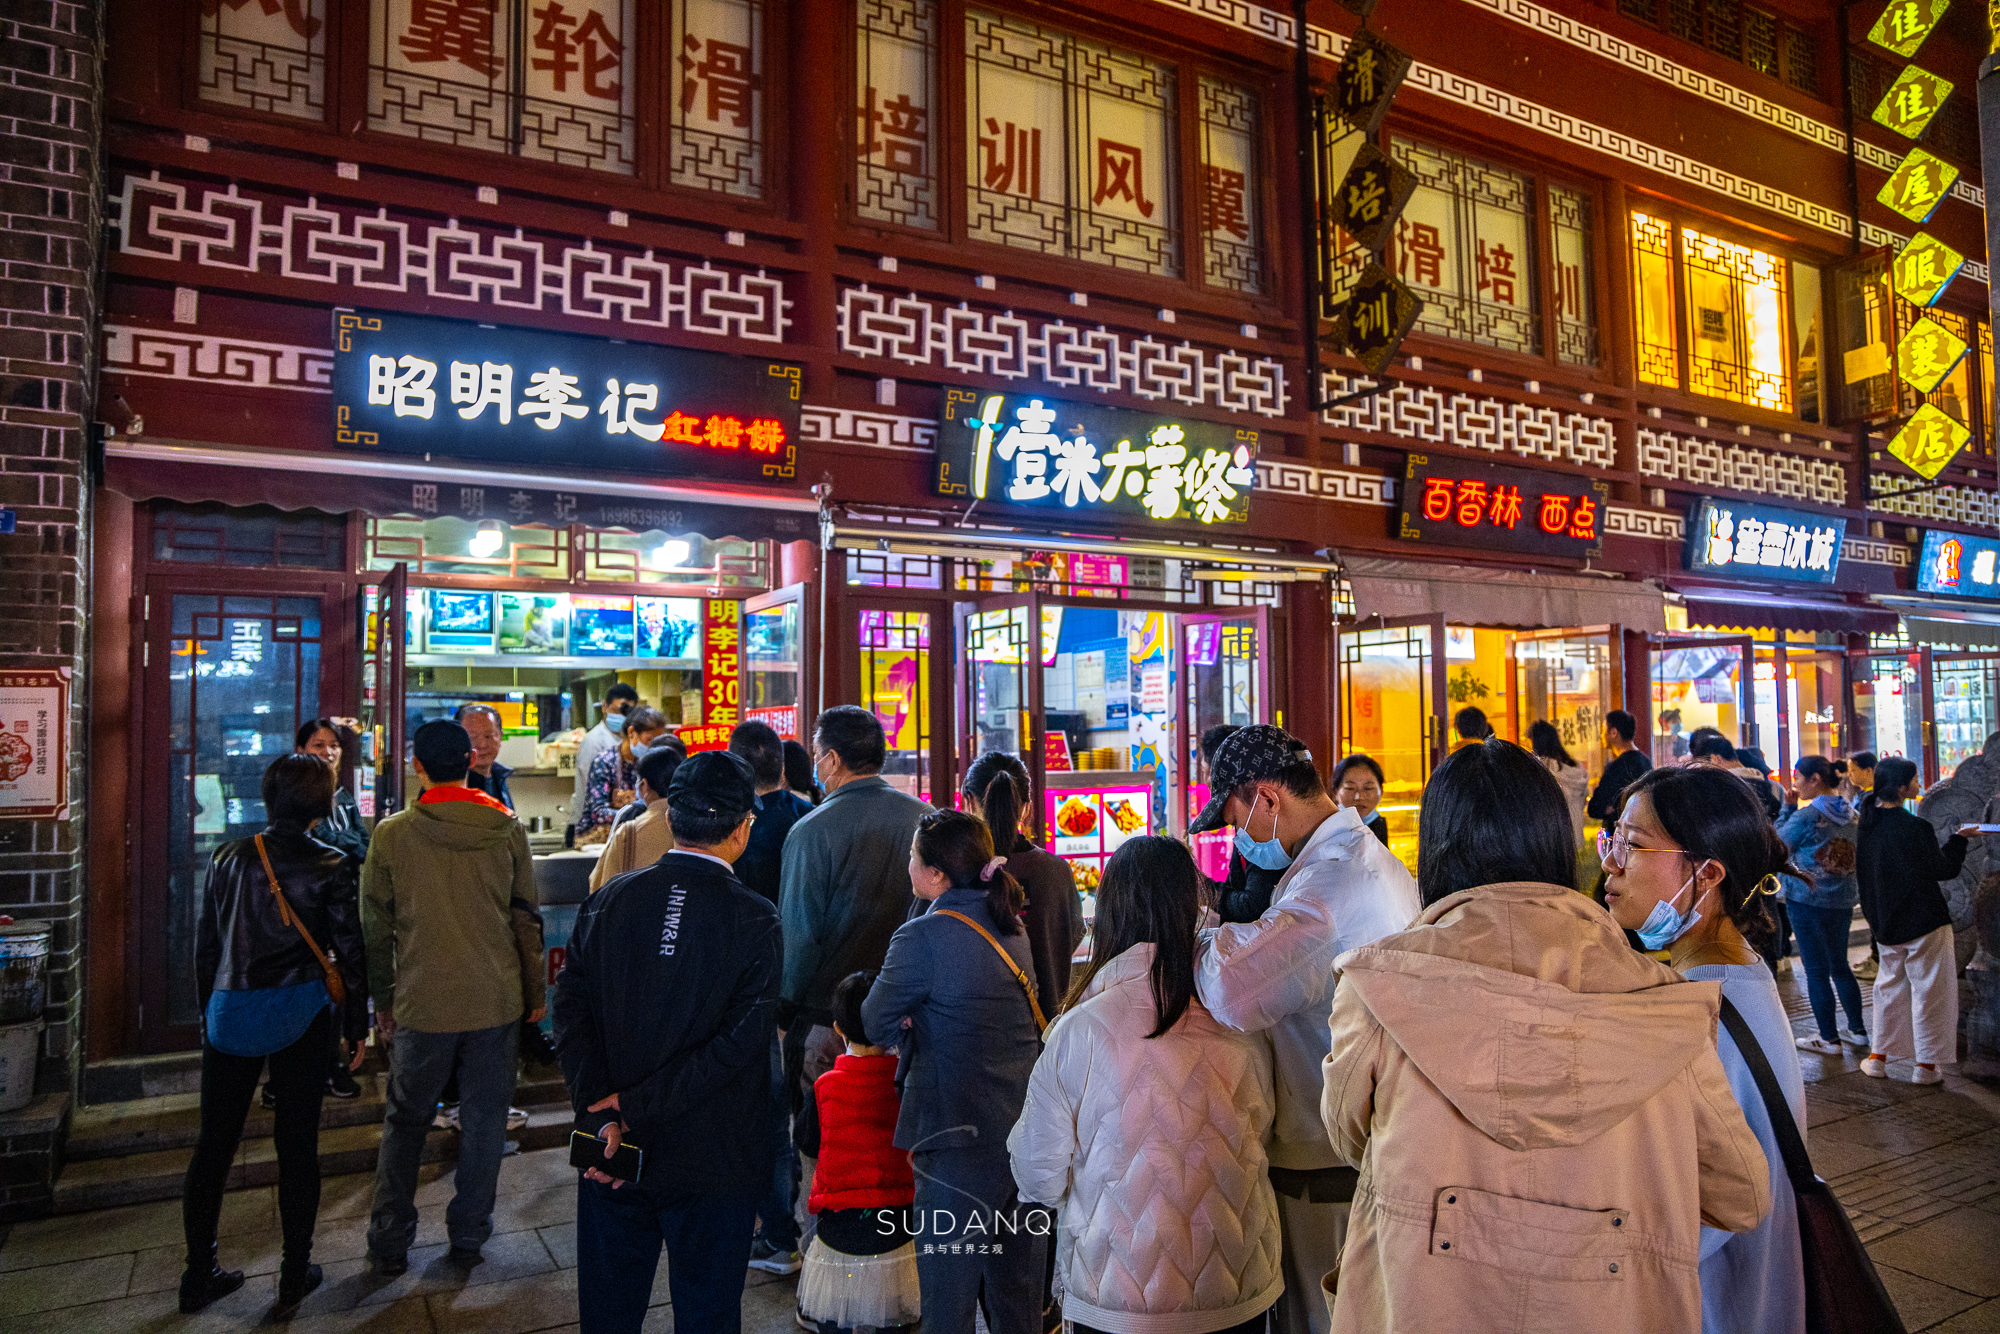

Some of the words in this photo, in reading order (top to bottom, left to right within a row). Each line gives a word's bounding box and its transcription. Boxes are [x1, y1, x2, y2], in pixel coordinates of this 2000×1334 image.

[367, 354, 667, 443] 昭明李记
[661, 411, 787, 453] 红糖饼
[412, 484, 578, 521] 昭明李记
[1425, 477, 1523, 530] 百香林
[1541, 494, 1596, 540] 西点
[1733, 518, 1836, 571] 蜜雪冰城
